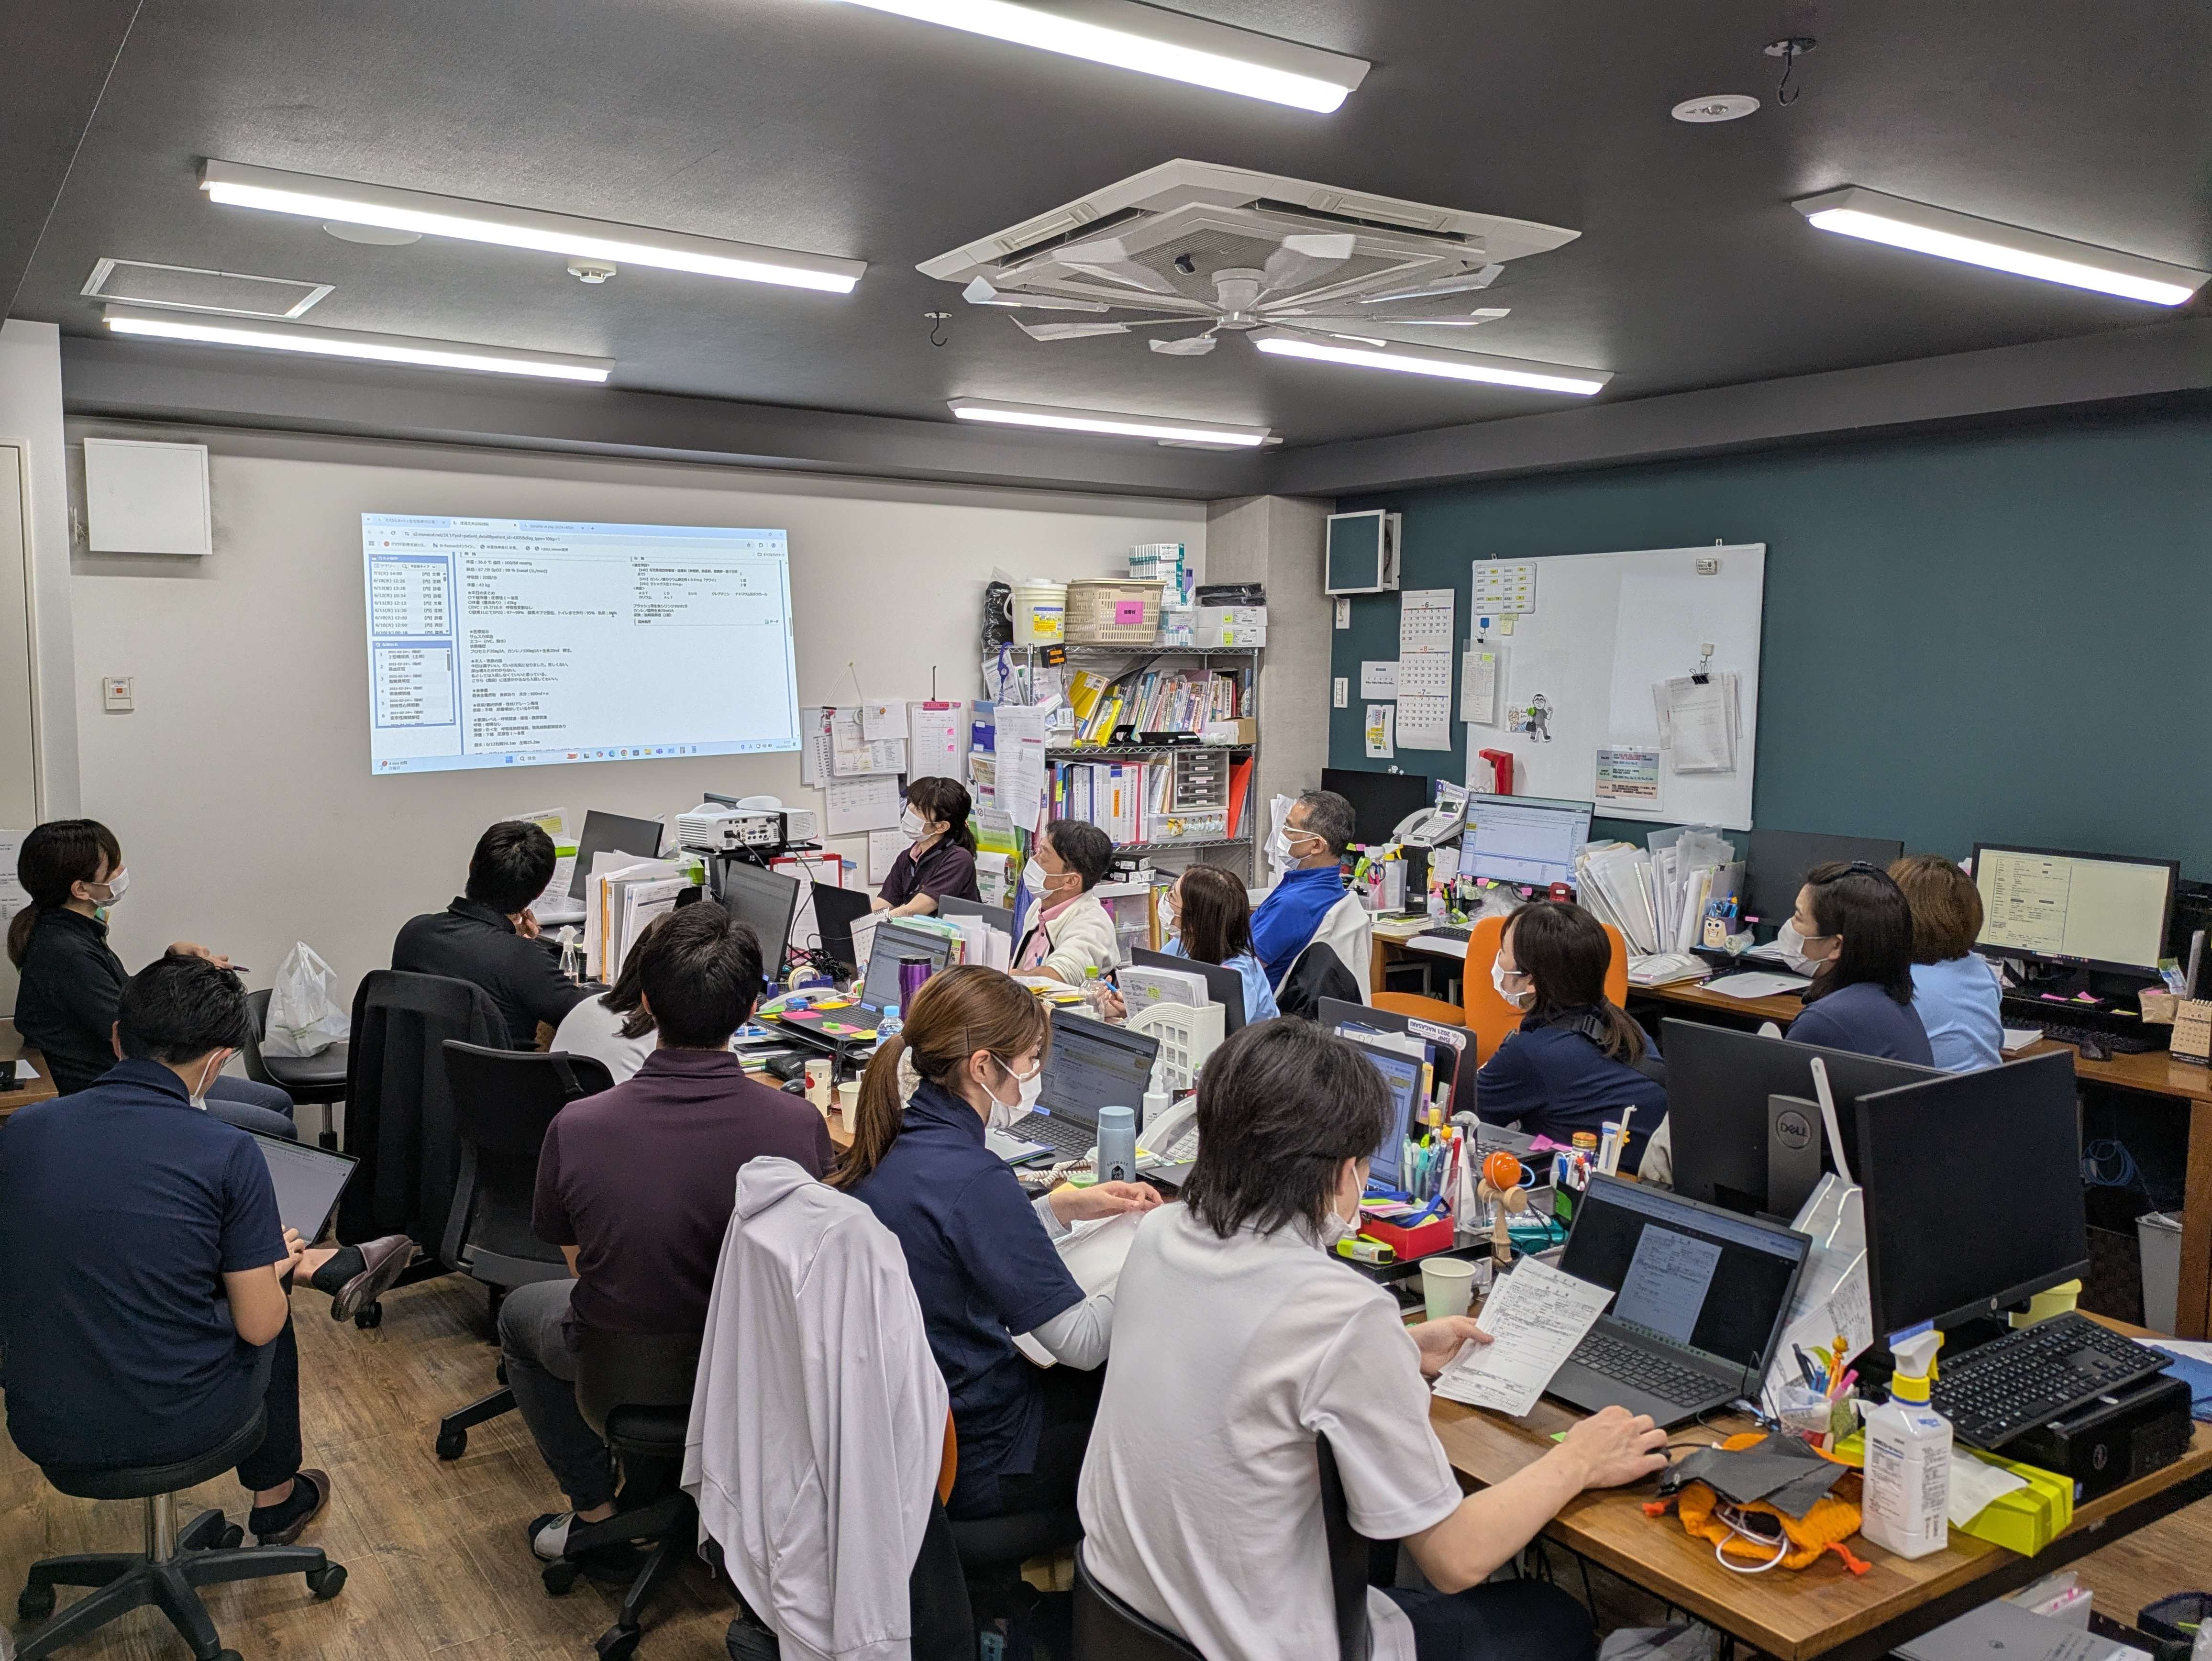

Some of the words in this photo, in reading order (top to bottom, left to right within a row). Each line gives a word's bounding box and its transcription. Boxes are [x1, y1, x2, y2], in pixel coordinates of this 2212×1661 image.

[1410, 1021, 1436, 1033] NAGASAKI
[1438, 1036, 1450, 1044] JSNP
[1781, 1123, 1807, 1137] DELL
